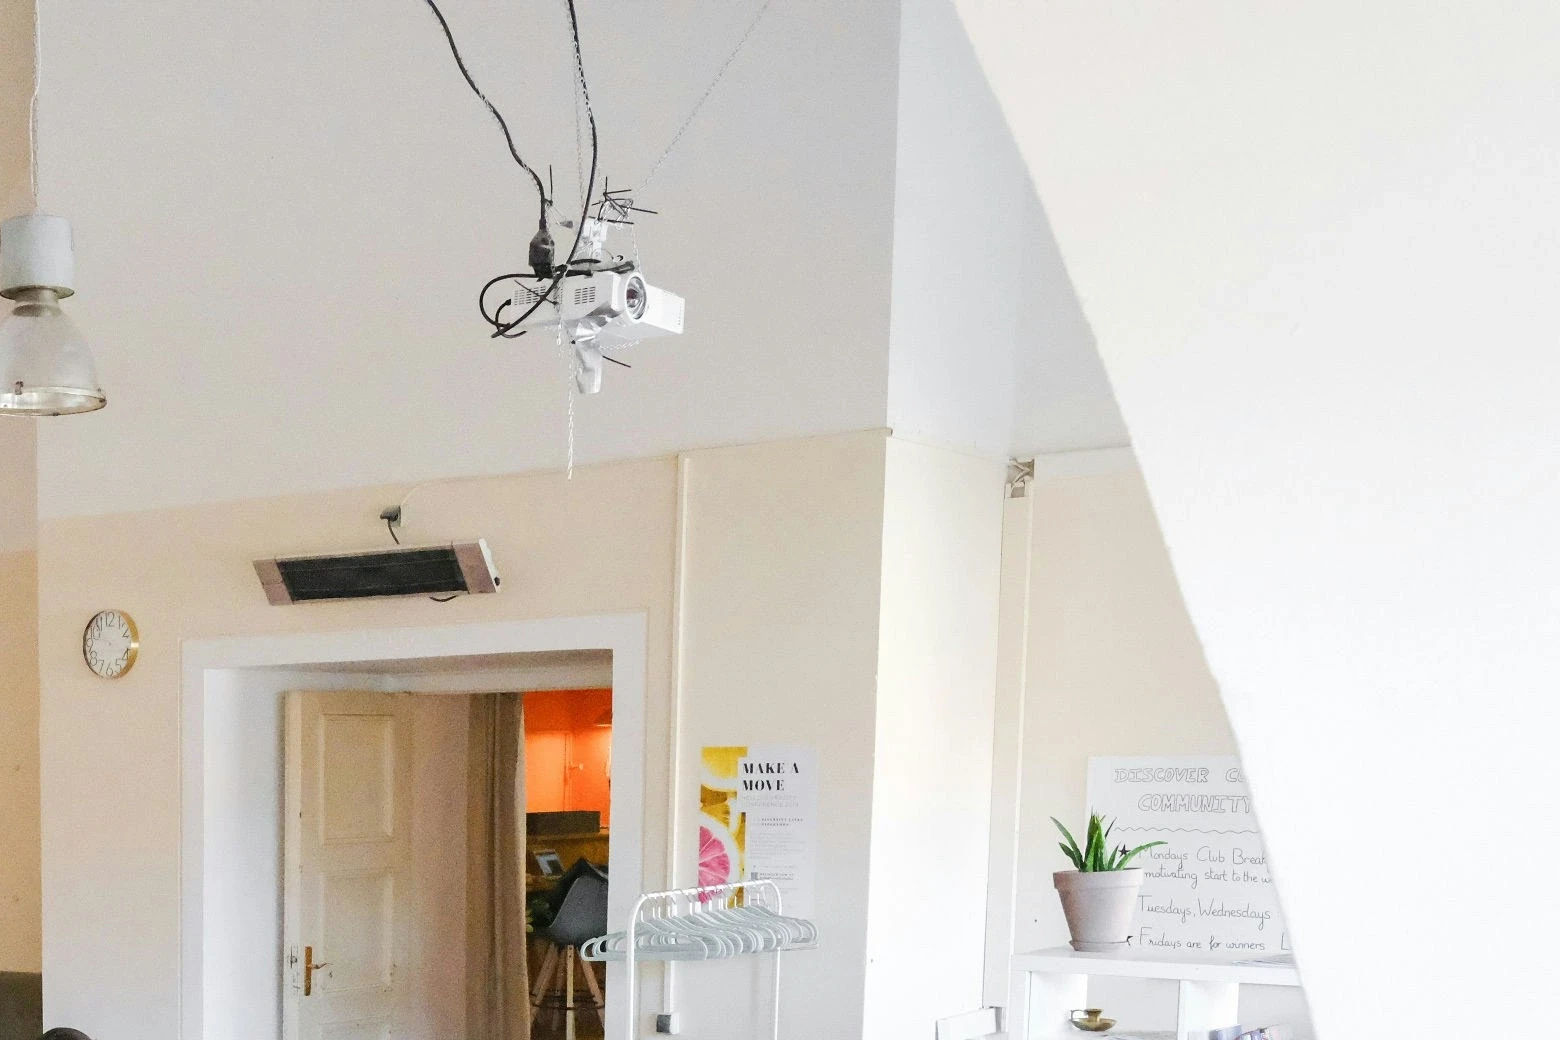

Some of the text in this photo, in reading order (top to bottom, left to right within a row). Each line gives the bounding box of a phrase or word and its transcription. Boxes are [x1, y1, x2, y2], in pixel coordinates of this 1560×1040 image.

[743, 762, 800, 775] MAKE A
[1113, 767, 1210, 784] DISCOVER
[743, 779, 785, 792] MOVE
[1196, 845, 1225, 863] Club
[1143, 863, 1198, 890] motivating
[1204, 867, 1228, 883] start
[1232, 868, 1241, 882] to
[1243, 870, 1259, 883] the
[1197, 897, 1271, 931] Wednesdays
[1139, 926, 1182, 950] Fridays
[1186, 941, 1202, 950] are
[1209, 935, 1221, 951] for
[1225, 939, 1266, 951] winners
